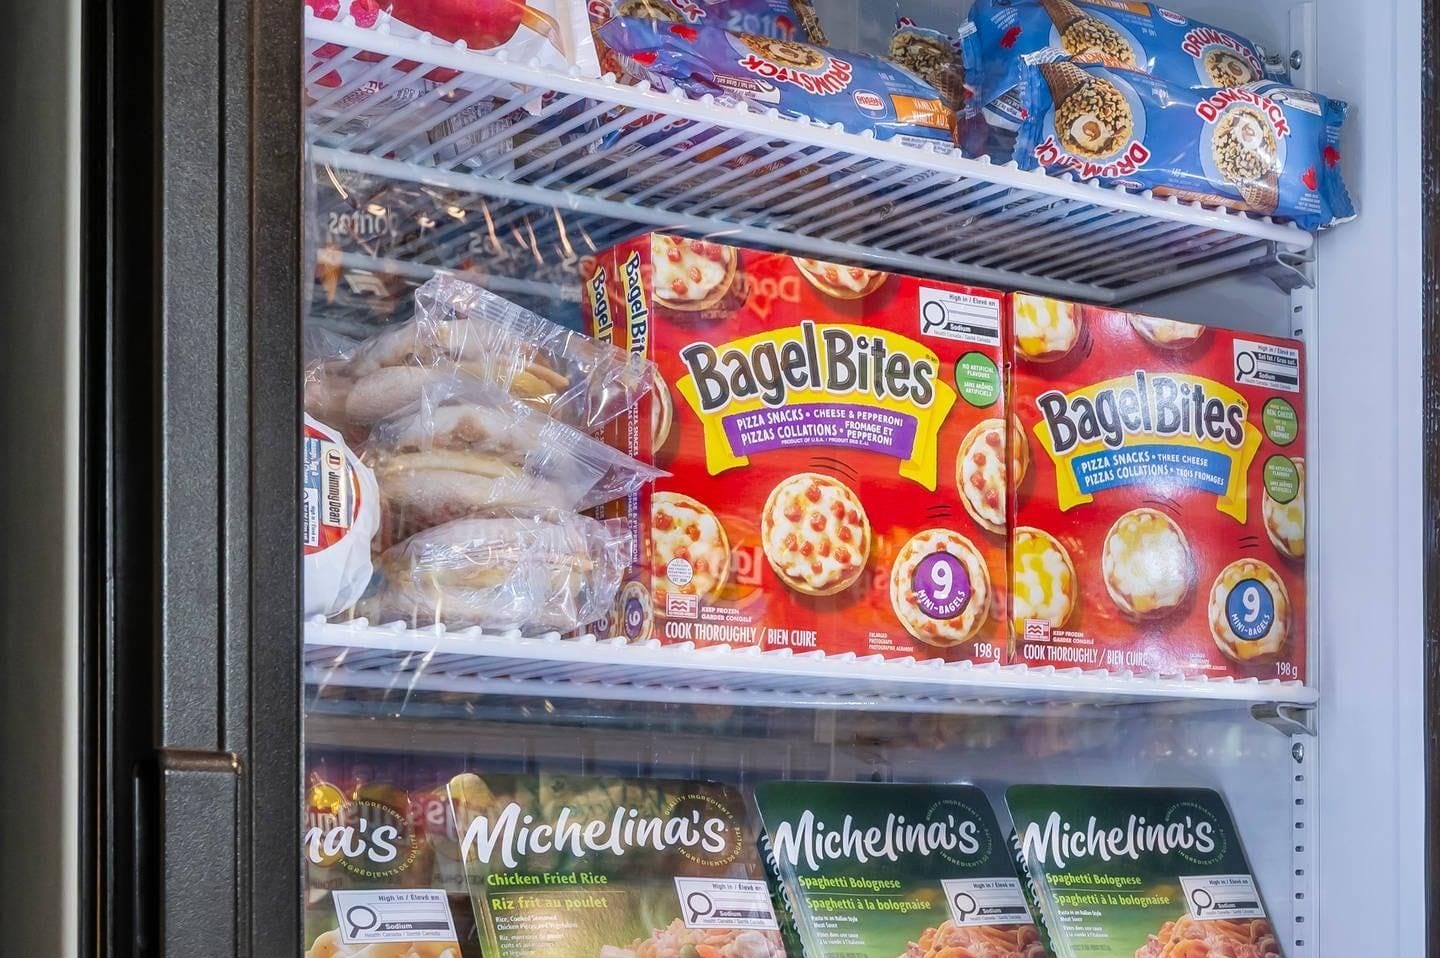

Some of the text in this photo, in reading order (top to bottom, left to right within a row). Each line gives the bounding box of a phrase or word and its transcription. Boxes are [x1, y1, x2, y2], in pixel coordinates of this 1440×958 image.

[684, 322, 936, 412] Bagel Bites
[737, 408, 904, 432] PIZZA SNACKS CHEESE & PEPPERONI
[1038, 371, 1245, 452] Bagel Bites
[741, 421, 894, 447] PIZZAS COLLATIONS FROMAGE ET
[847, 430, 893, 446] PEPPERONI
[1081, 451, 1209, 474] PIZZA SNACKS THREE CHEESE
[1084, 464, 1225, 487] PIZZAS COLLATIONS TROIS FROMAGES
[327, 470, 342, 523] Jimmy Dean
[931, 560, 953, 599] 9
[916, 589, 966, 614] MINI-BAGELS
[665, 621, 818, 648] COOK THOROUGHLY / BIEN CUIRE
[974, 642, 1001, 663] 198 g
[462, 800, 727, 868] Michelina's
[772, 808, 980, 872] Michelina's
[1021, 811, 1216, 871] Michelina's
[487, 871, 608, 886] Chicken Fried Rice
[799, 875, 901, 890] Spaghetti Bolognese
[492, 898, 516, 910] Riz
[518, 896, 543, 909] frit
[565, 896, 609, 911] poulet
[806, 897, 932, 914] Spaghetti à la bolognaise
[385, 922, 413, 931] Sodium
